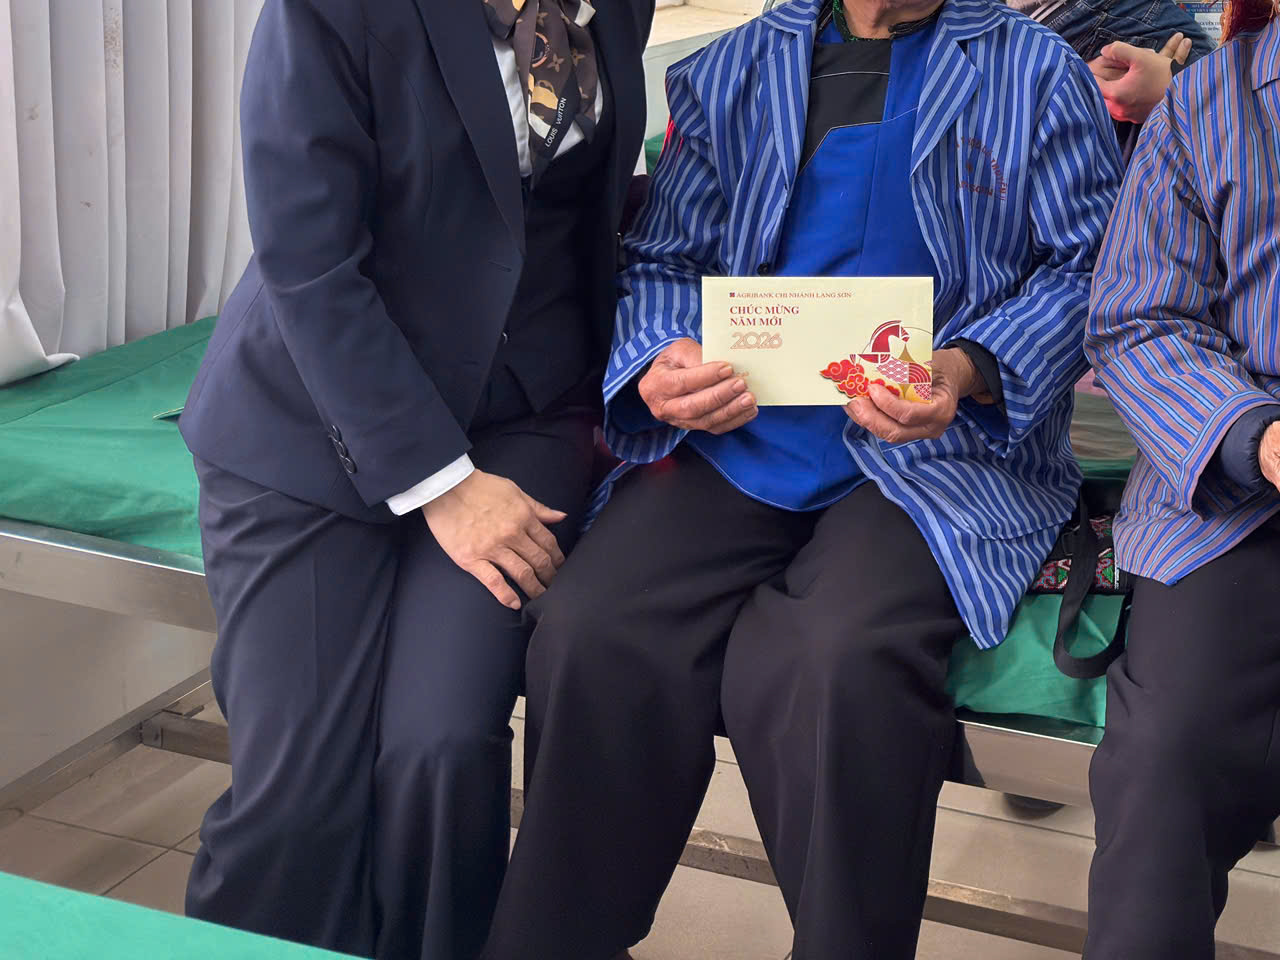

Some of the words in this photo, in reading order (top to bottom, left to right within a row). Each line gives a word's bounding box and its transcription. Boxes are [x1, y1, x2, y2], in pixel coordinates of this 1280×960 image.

[545, 127, 558, 148] LOUIS
[555, 97, 567, 125] VUITTON
[729, 304, 762, 315] CHÚC
[765, 304, 800, 315] MỪNG
[730, 316, 756, 326] NĂM
[759, 316, 783, 326] MỚI
[730, 331, 783, 350] 2026
